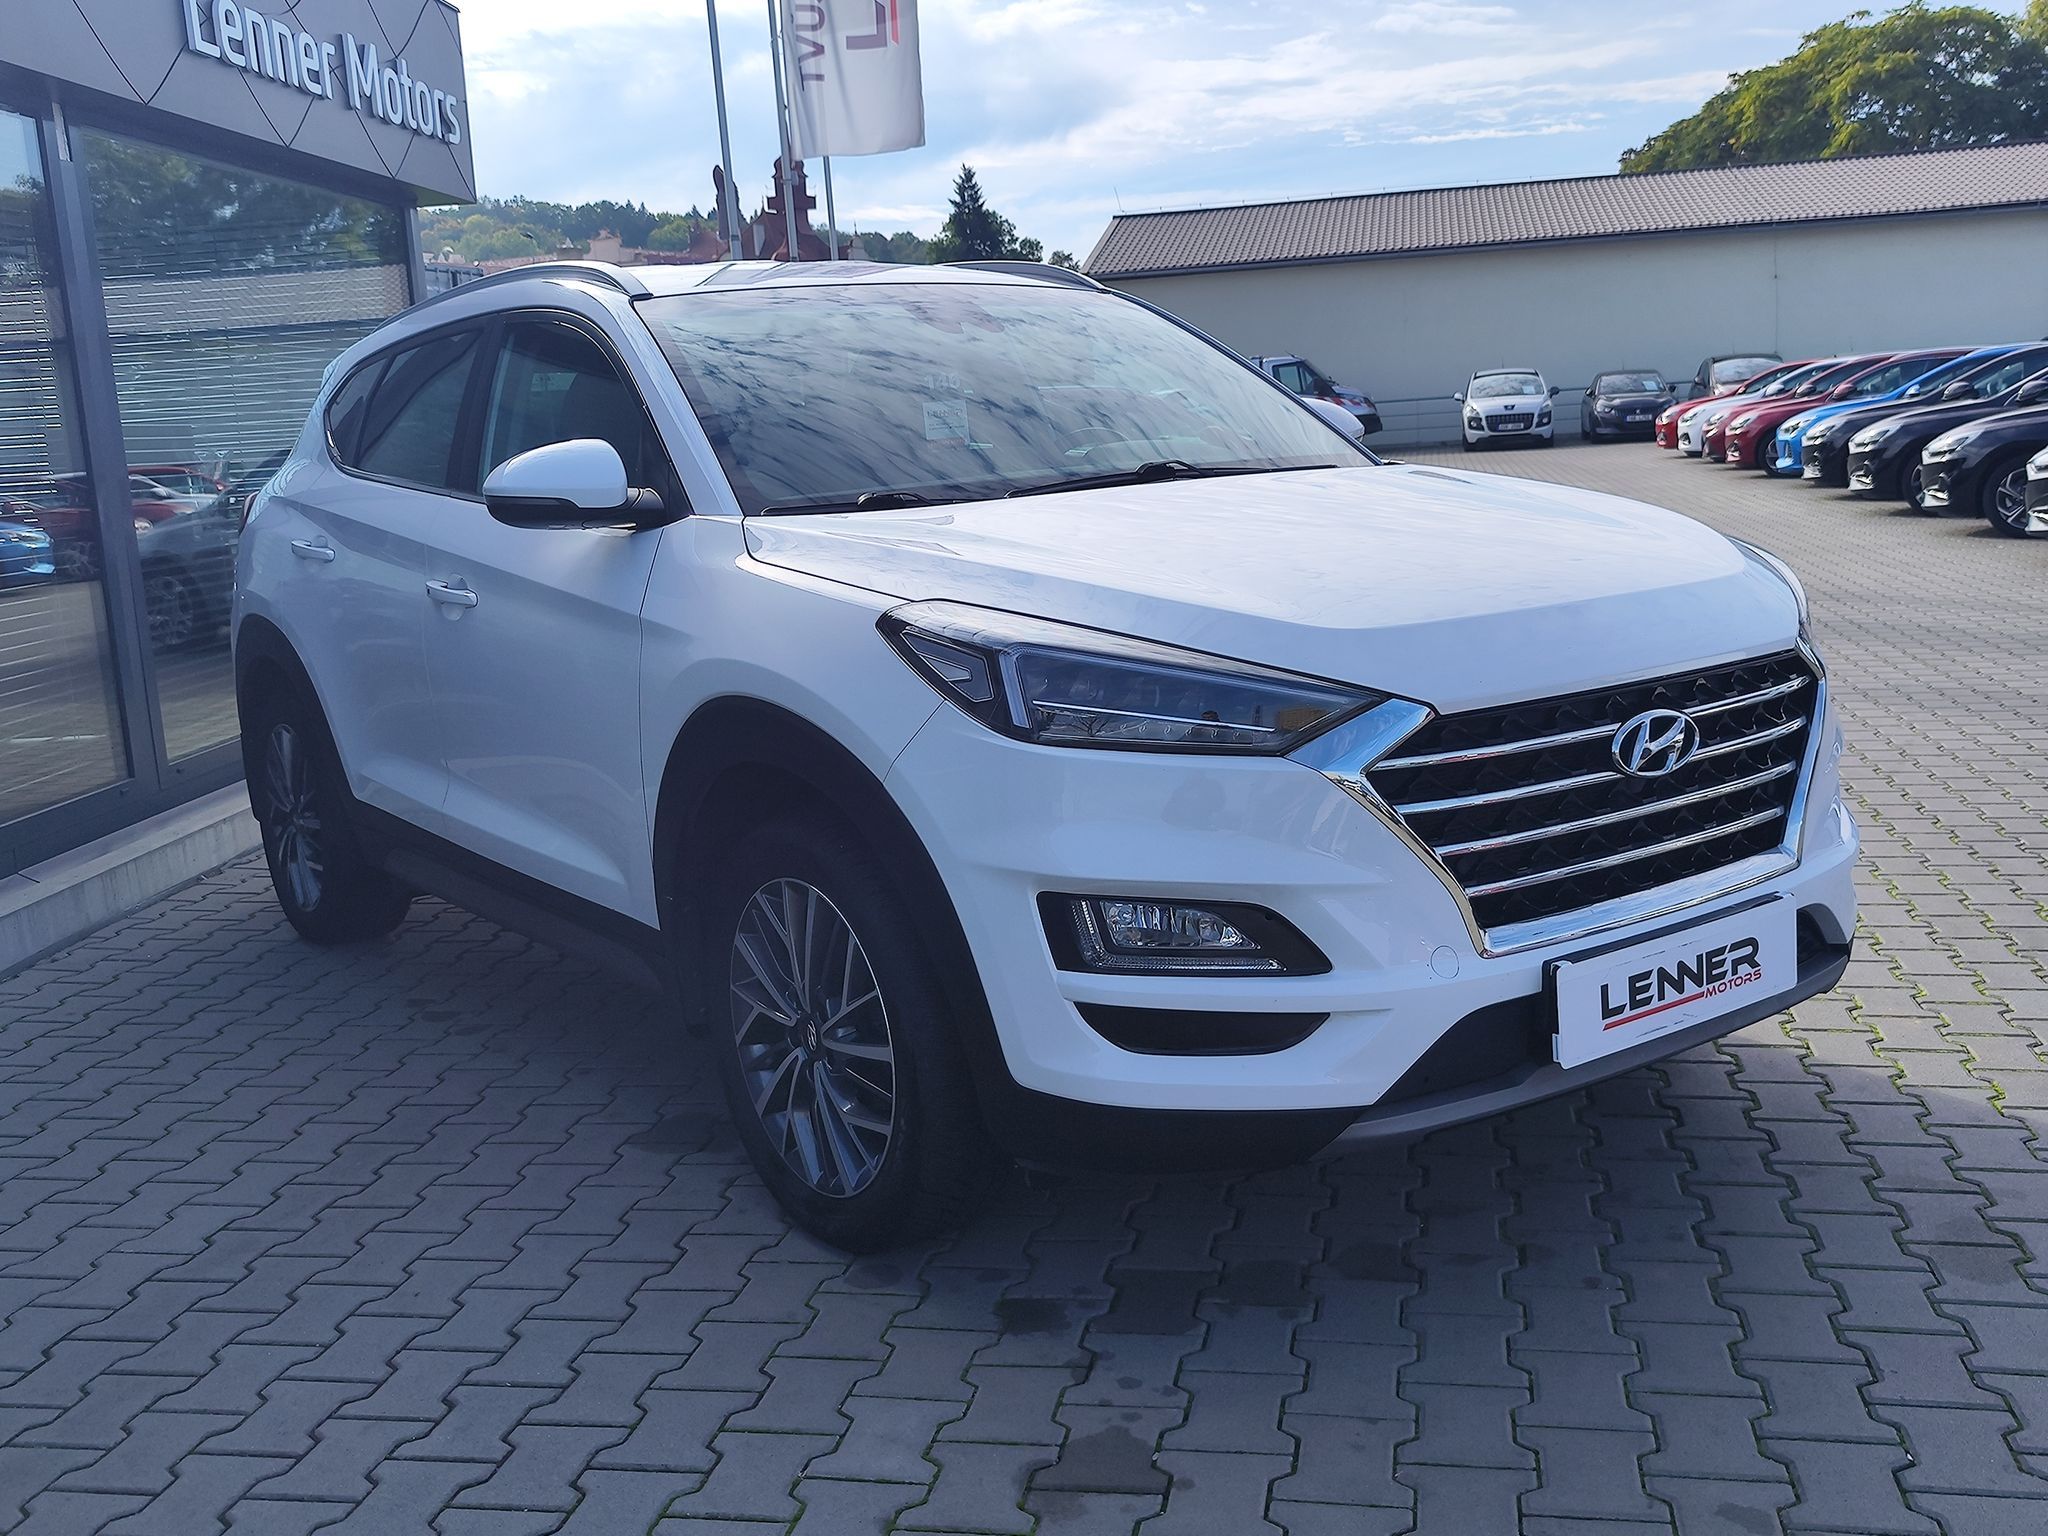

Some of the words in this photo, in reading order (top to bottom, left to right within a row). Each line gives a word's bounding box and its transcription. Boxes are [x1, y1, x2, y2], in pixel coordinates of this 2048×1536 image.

[182, 0, 336, 99] Lenner
[340, 32, 461, 145] Motors
[1600, 936, 1762, 1020] LENNER
[1704, 968, 1762, 998] MOTORS
